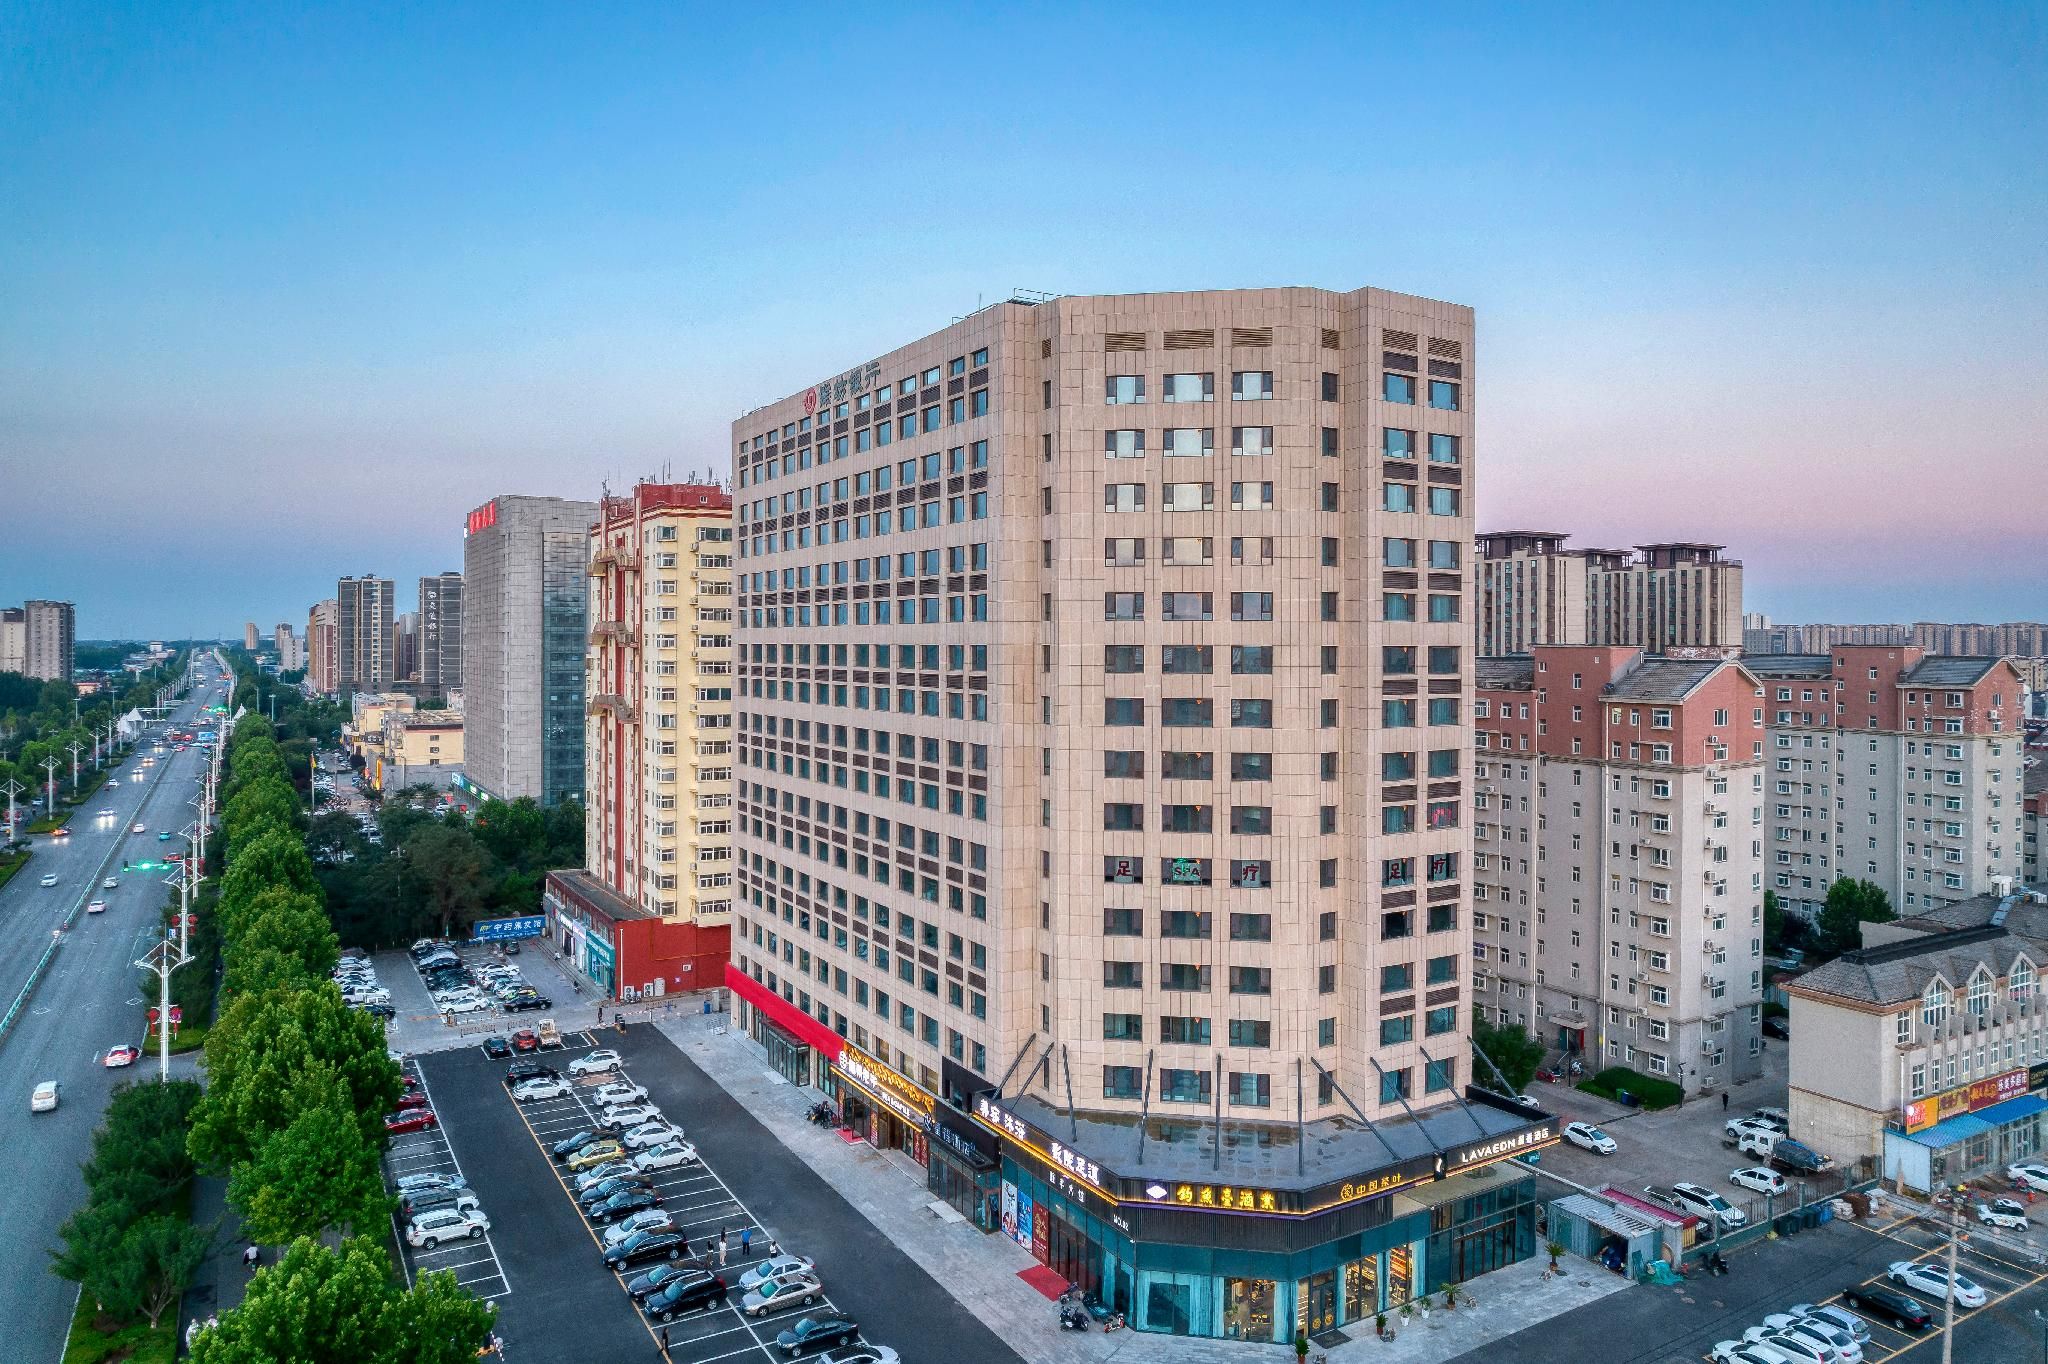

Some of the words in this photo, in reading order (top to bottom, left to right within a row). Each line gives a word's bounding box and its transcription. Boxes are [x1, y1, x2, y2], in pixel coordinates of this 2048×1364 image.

[1116, 861, 1132, 877] 足
[1174, 866, 1201, 877] SPA
[1242, 863, 1260, 881] 疗
[1390, 863, 1401, 879] 足
[1433, 858, 1446, 875] 疗
